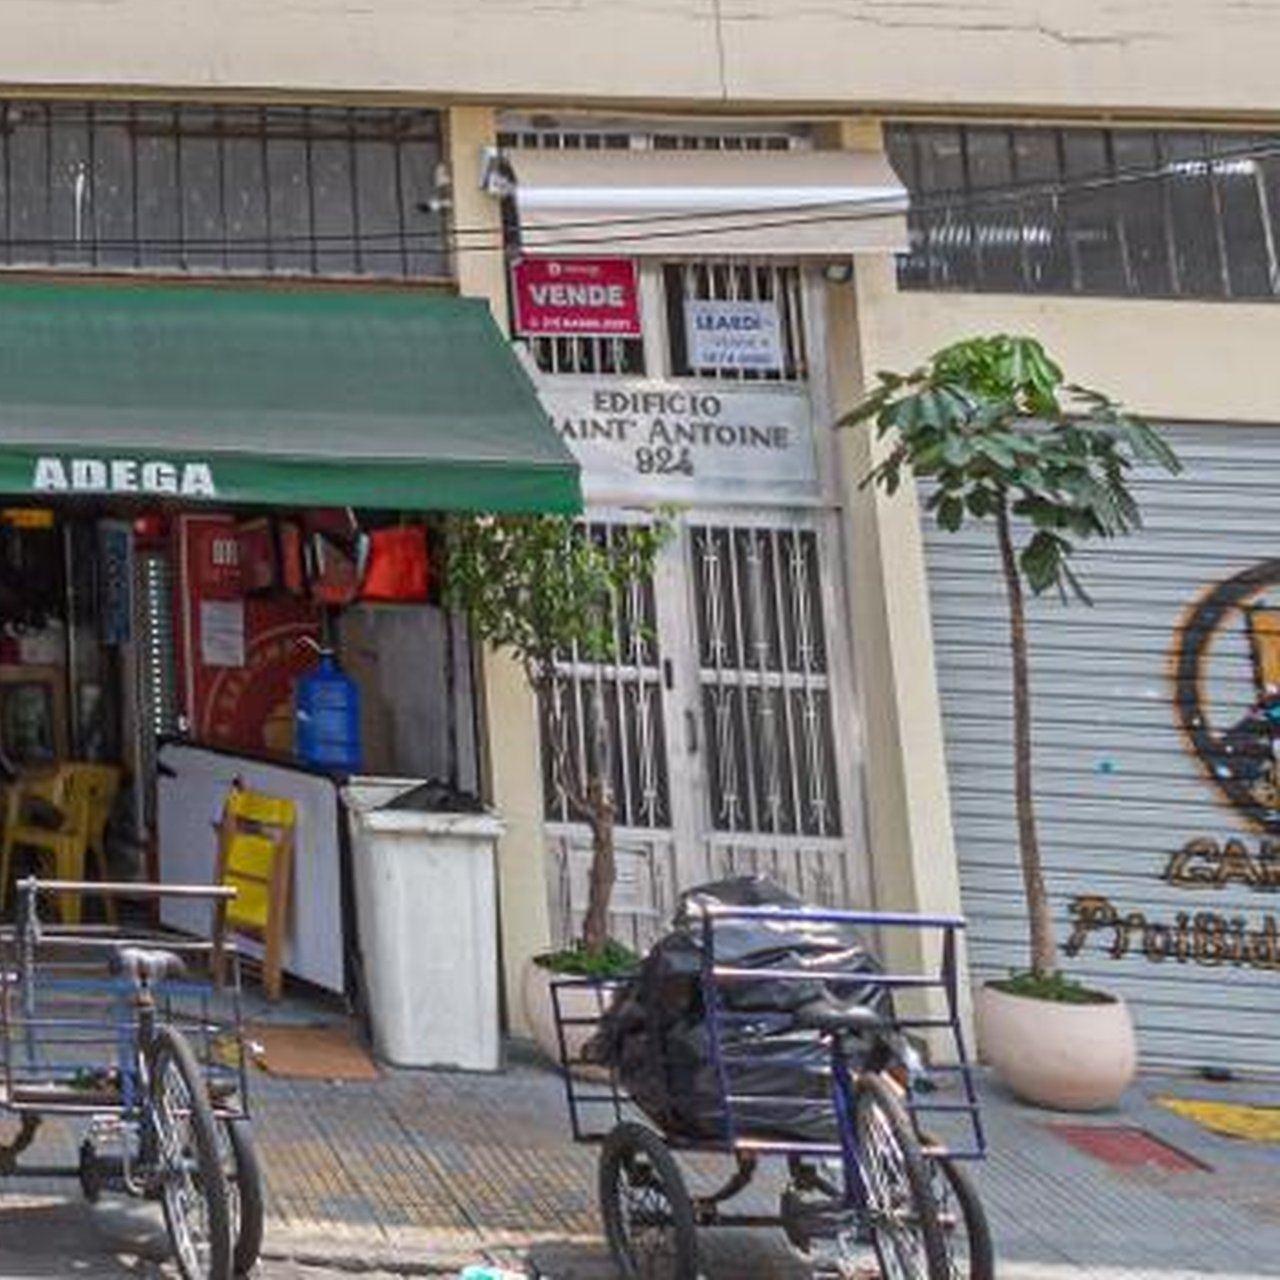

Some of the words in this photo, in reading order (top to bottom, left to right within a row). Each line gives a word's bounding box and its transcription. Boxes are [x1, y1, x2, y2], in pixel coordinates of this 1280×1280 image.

[527, 282, 625, 308] VENDE
[594, 389, 723, 418] EDIFICIO
[548, 416, 638, 442] AINT'
[648, 419, 791, 450] ANTOINE
[33, 457, 216, 496] ADEGA
[636, 445, 694, 477] 924
